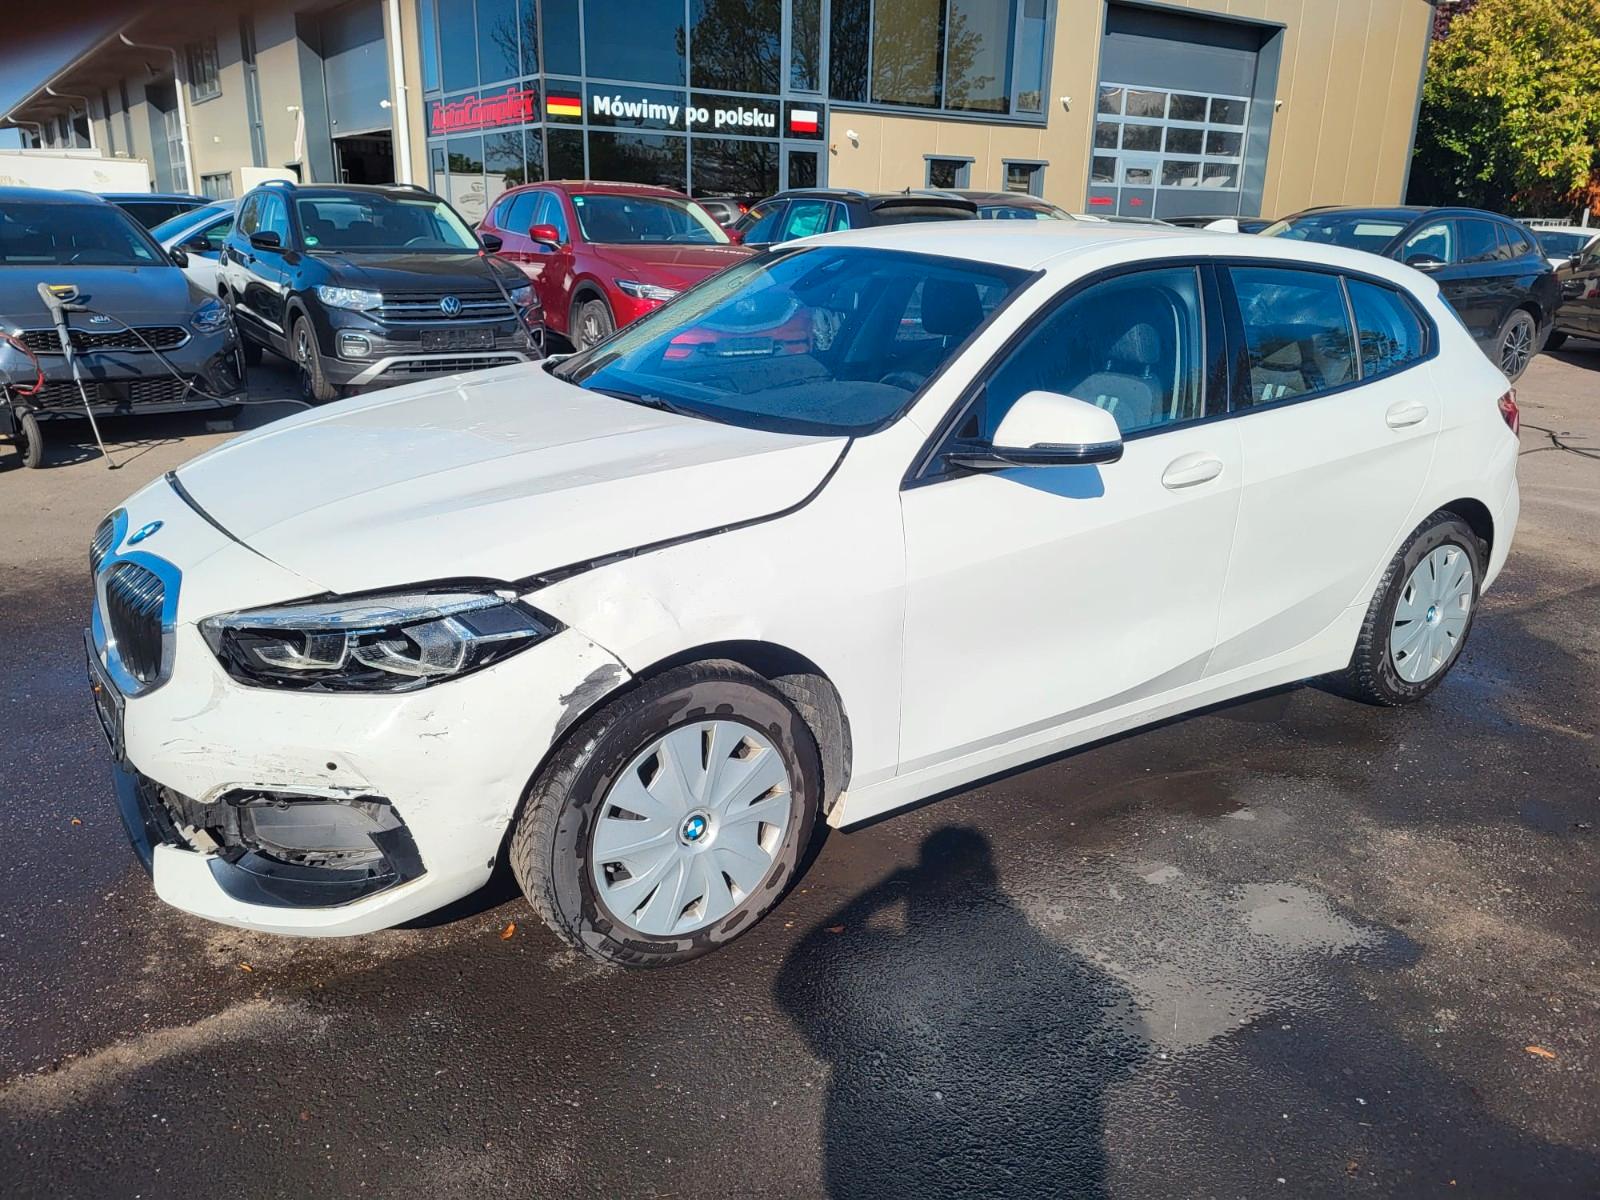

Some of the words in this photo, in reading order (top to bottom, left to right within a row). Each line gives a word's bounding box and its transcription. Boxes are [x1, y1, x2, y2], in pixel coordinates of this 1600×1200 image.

[593, 95, 679, 125] Mówimy
[685, 106, 709, 126] po
[714, 107, 775, 128] polsku
